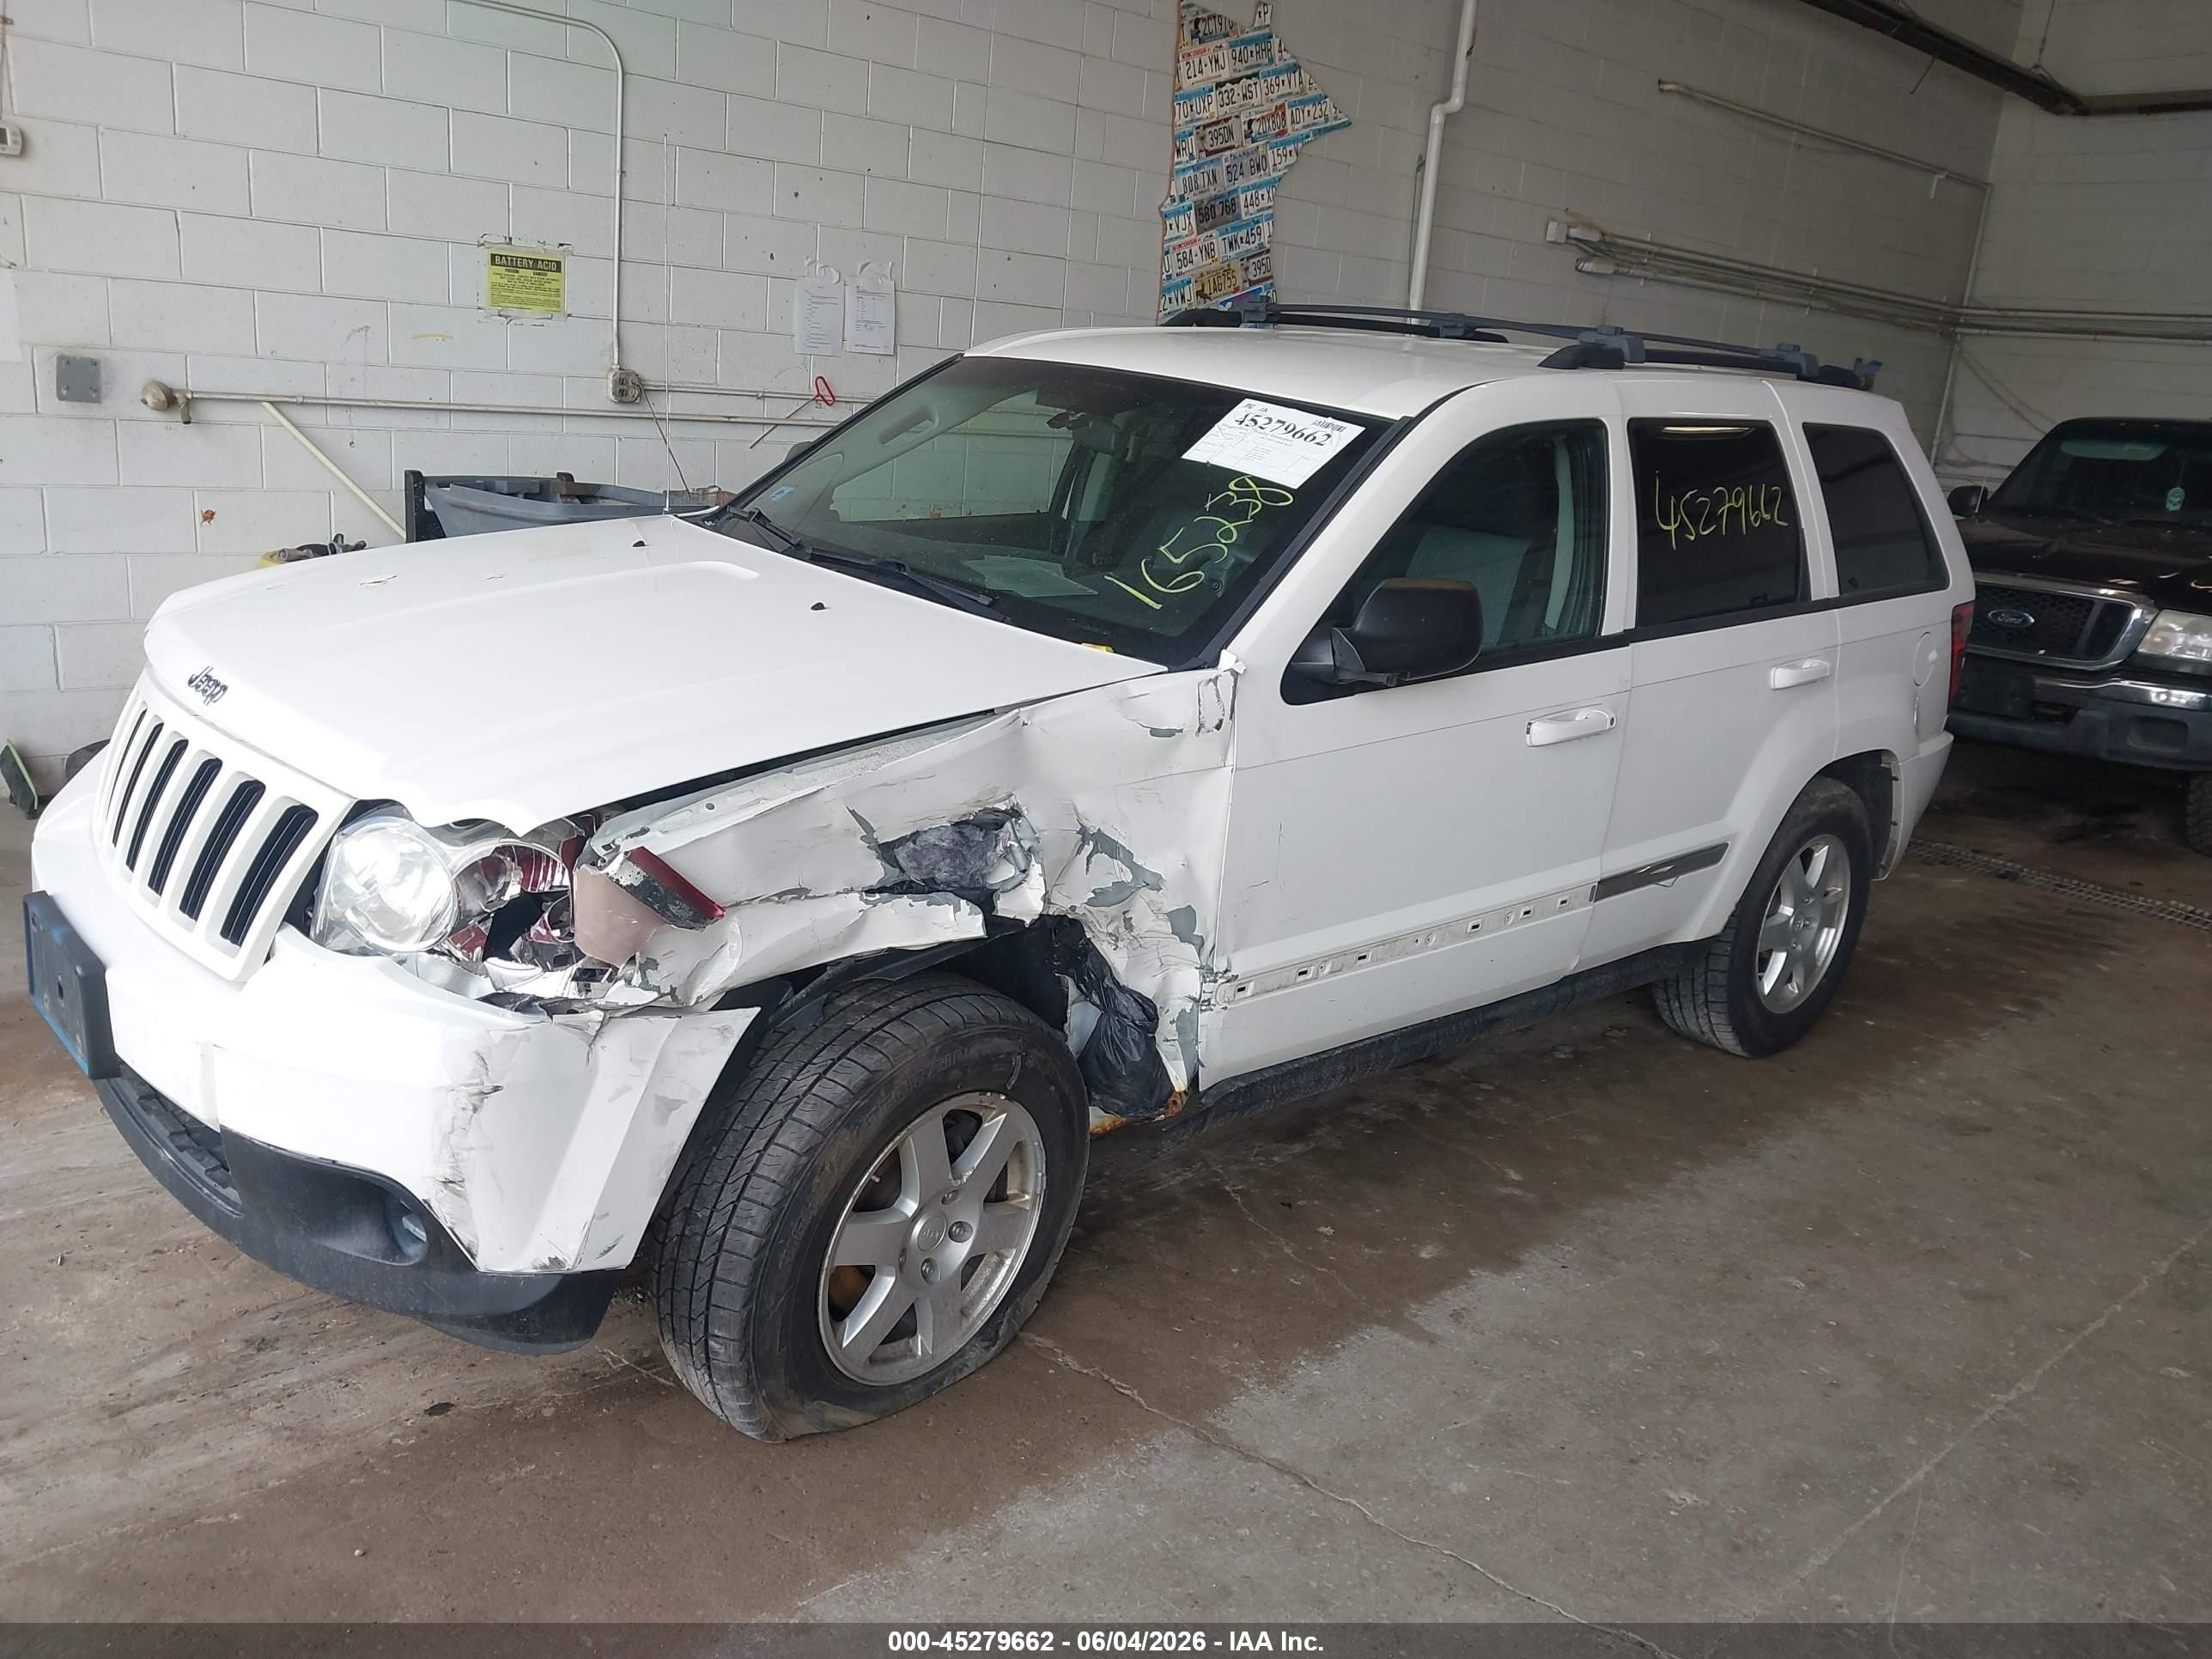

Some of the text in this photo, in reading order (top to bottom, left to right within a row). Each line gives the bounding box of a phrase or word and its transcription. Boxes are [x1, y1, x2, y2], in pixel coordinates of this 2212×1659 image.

[495, 255, 557, 271] BATTERY ACID
[1235, 412, 1331, 447] 45279662
[1655, 471, 1790, 550] 45279662
[187, 665, 229, 706] Jeep
